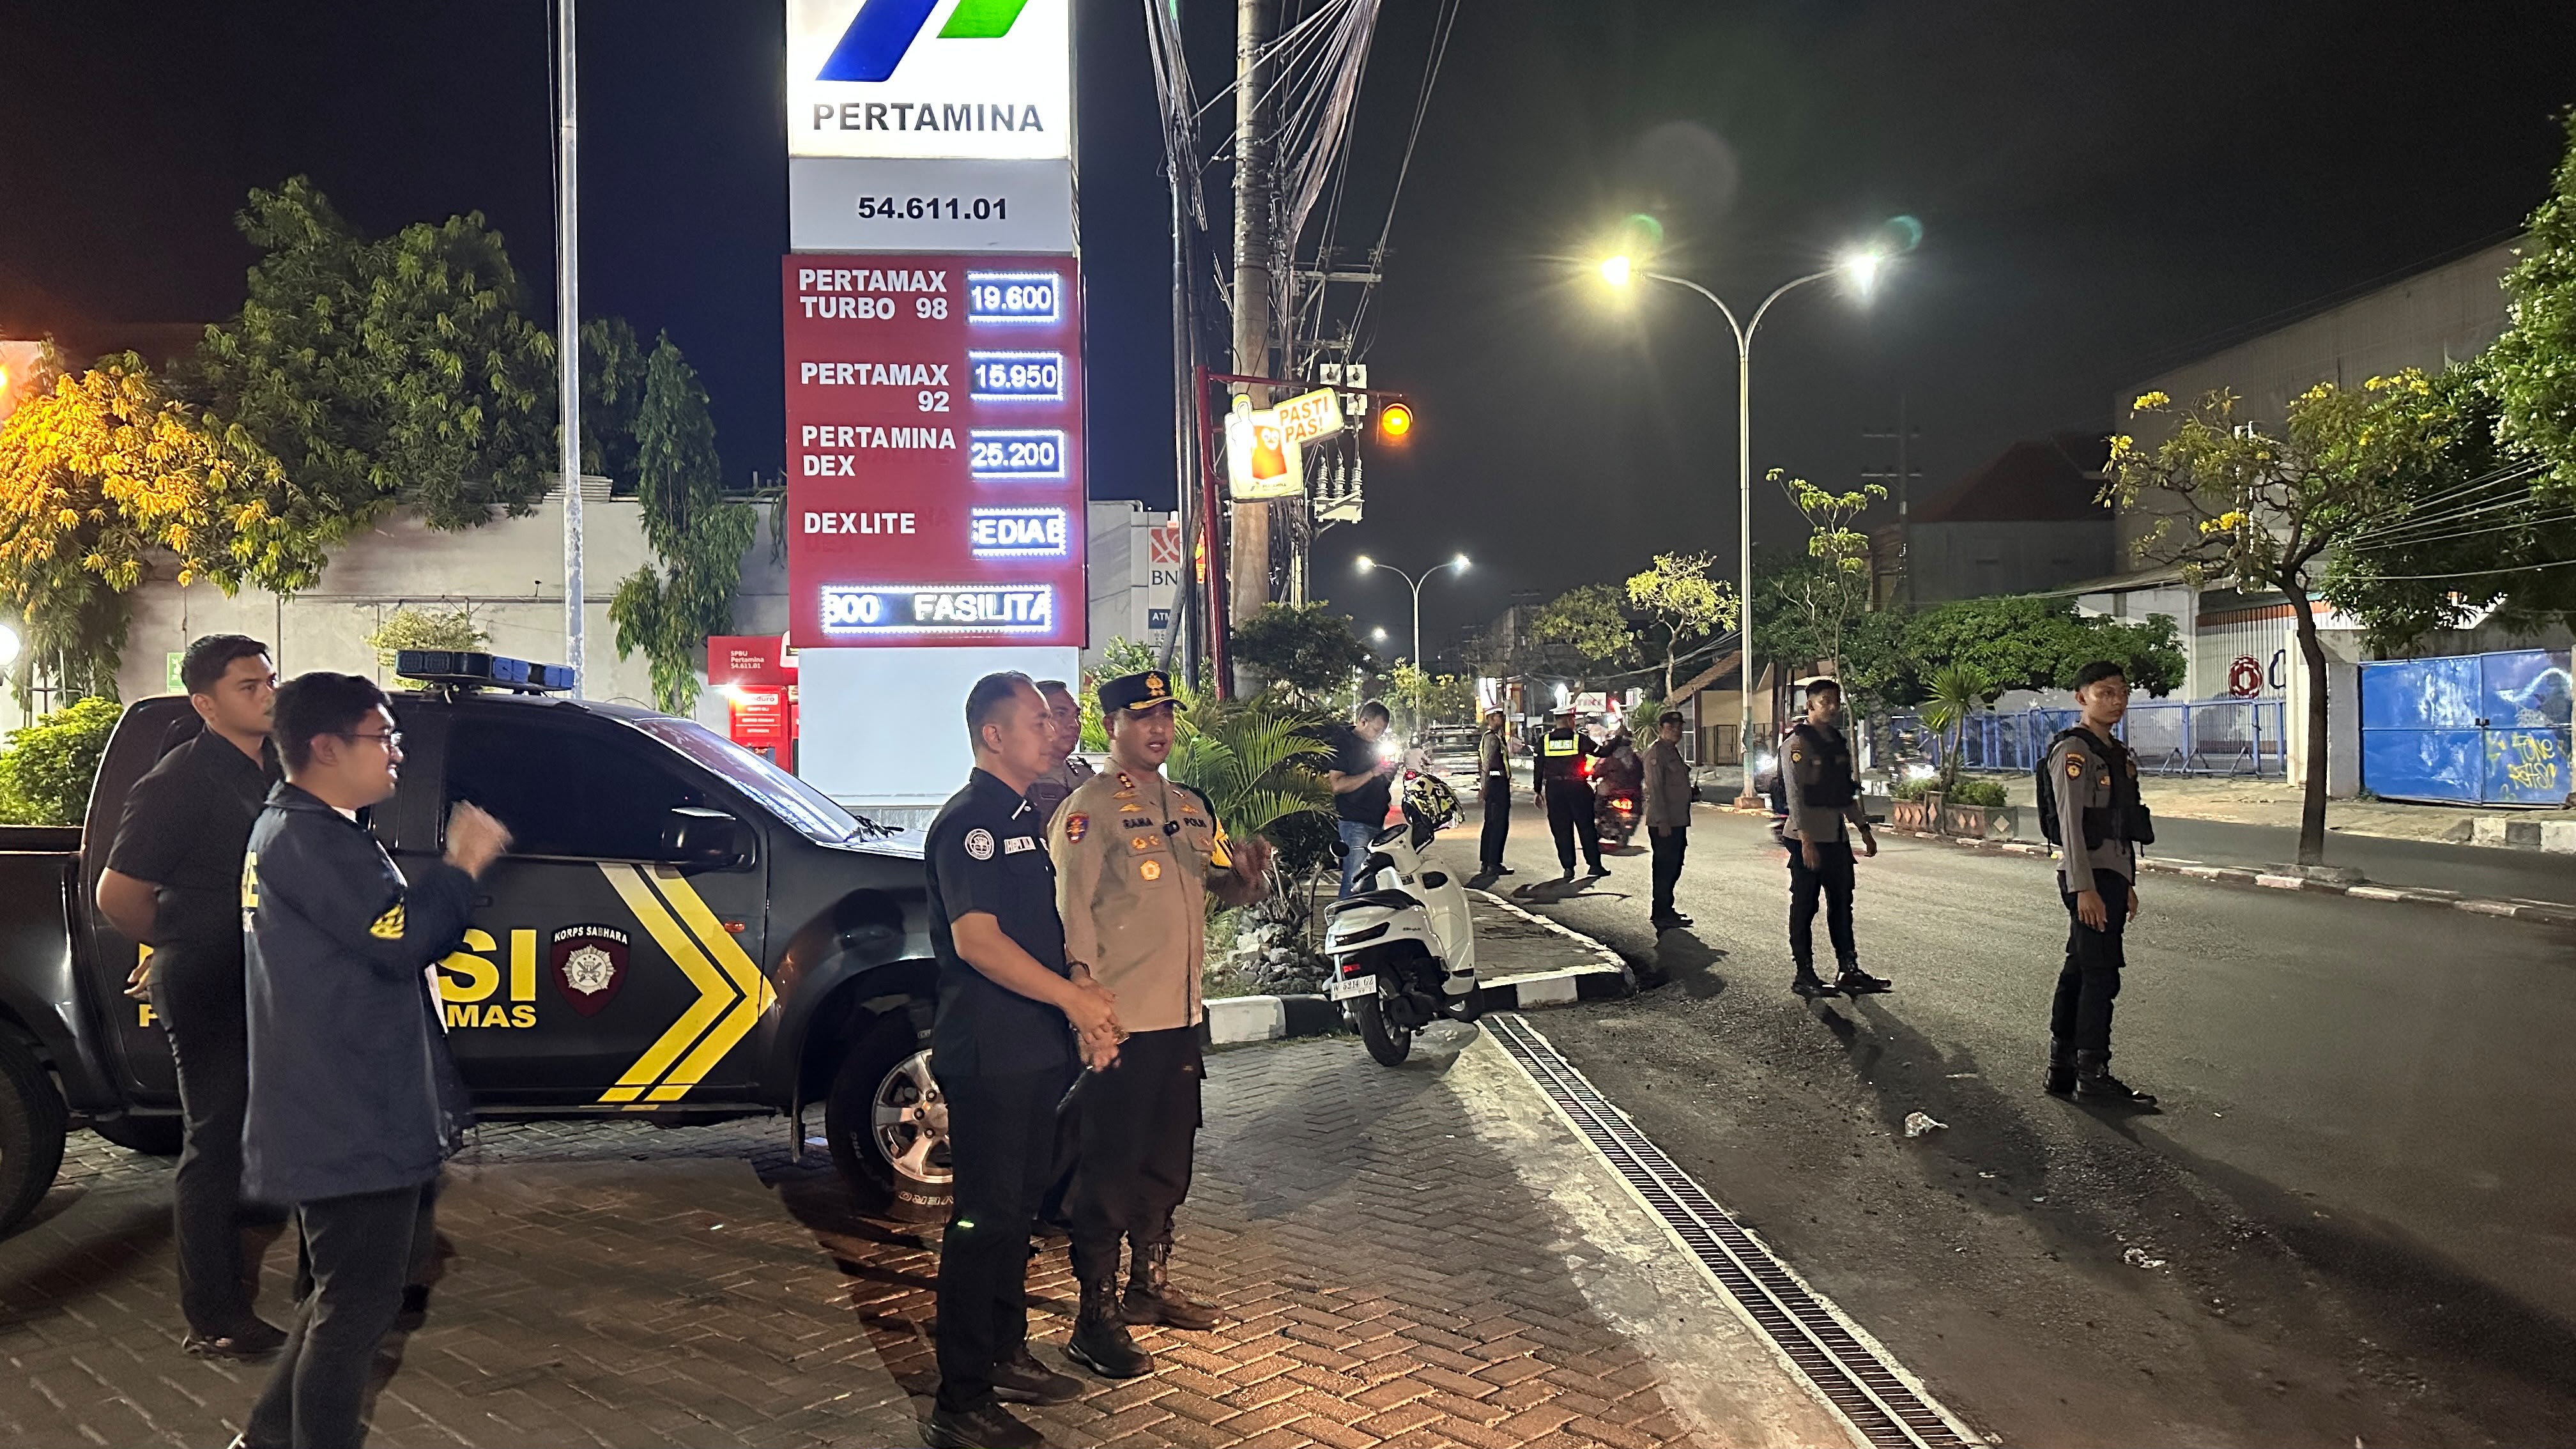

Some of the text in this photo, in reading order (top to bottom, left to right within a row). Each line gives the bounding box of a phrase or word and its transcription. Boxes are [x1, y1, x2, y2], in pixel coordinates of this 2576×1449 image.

[813, 103, 1044, 132] PERTAMINA
[858, 197, 1007, 219] 54.611.01
[799, 269, 947, 292] PERTAMAX
[800, 296, 948, 320] TURBO 98
[971, 286, 1052, 310] 19.600
[801, 363, 949, 386] PERTAMAX
[975, 364, 1057, 388] 15.950
[918, 390, 949, 412] 92
[1280, 396, 1328, 426] PASTI
[802, 425, 956, 449] PERTAMINA
[1285, 416, 1323, 443] PAS!
[803, 455, 856, 477] DEX
[970, 442, 1055, 467] 25.200
[804, 512, 916, 534] DEXLITE
[1152, 570, 1178, 585] BN
[914, 593, 1045, 621] FASILITA
[1549, 740, 1573, 749] POLISI
[554, 926, 628, 944] KORPS SABHARA
